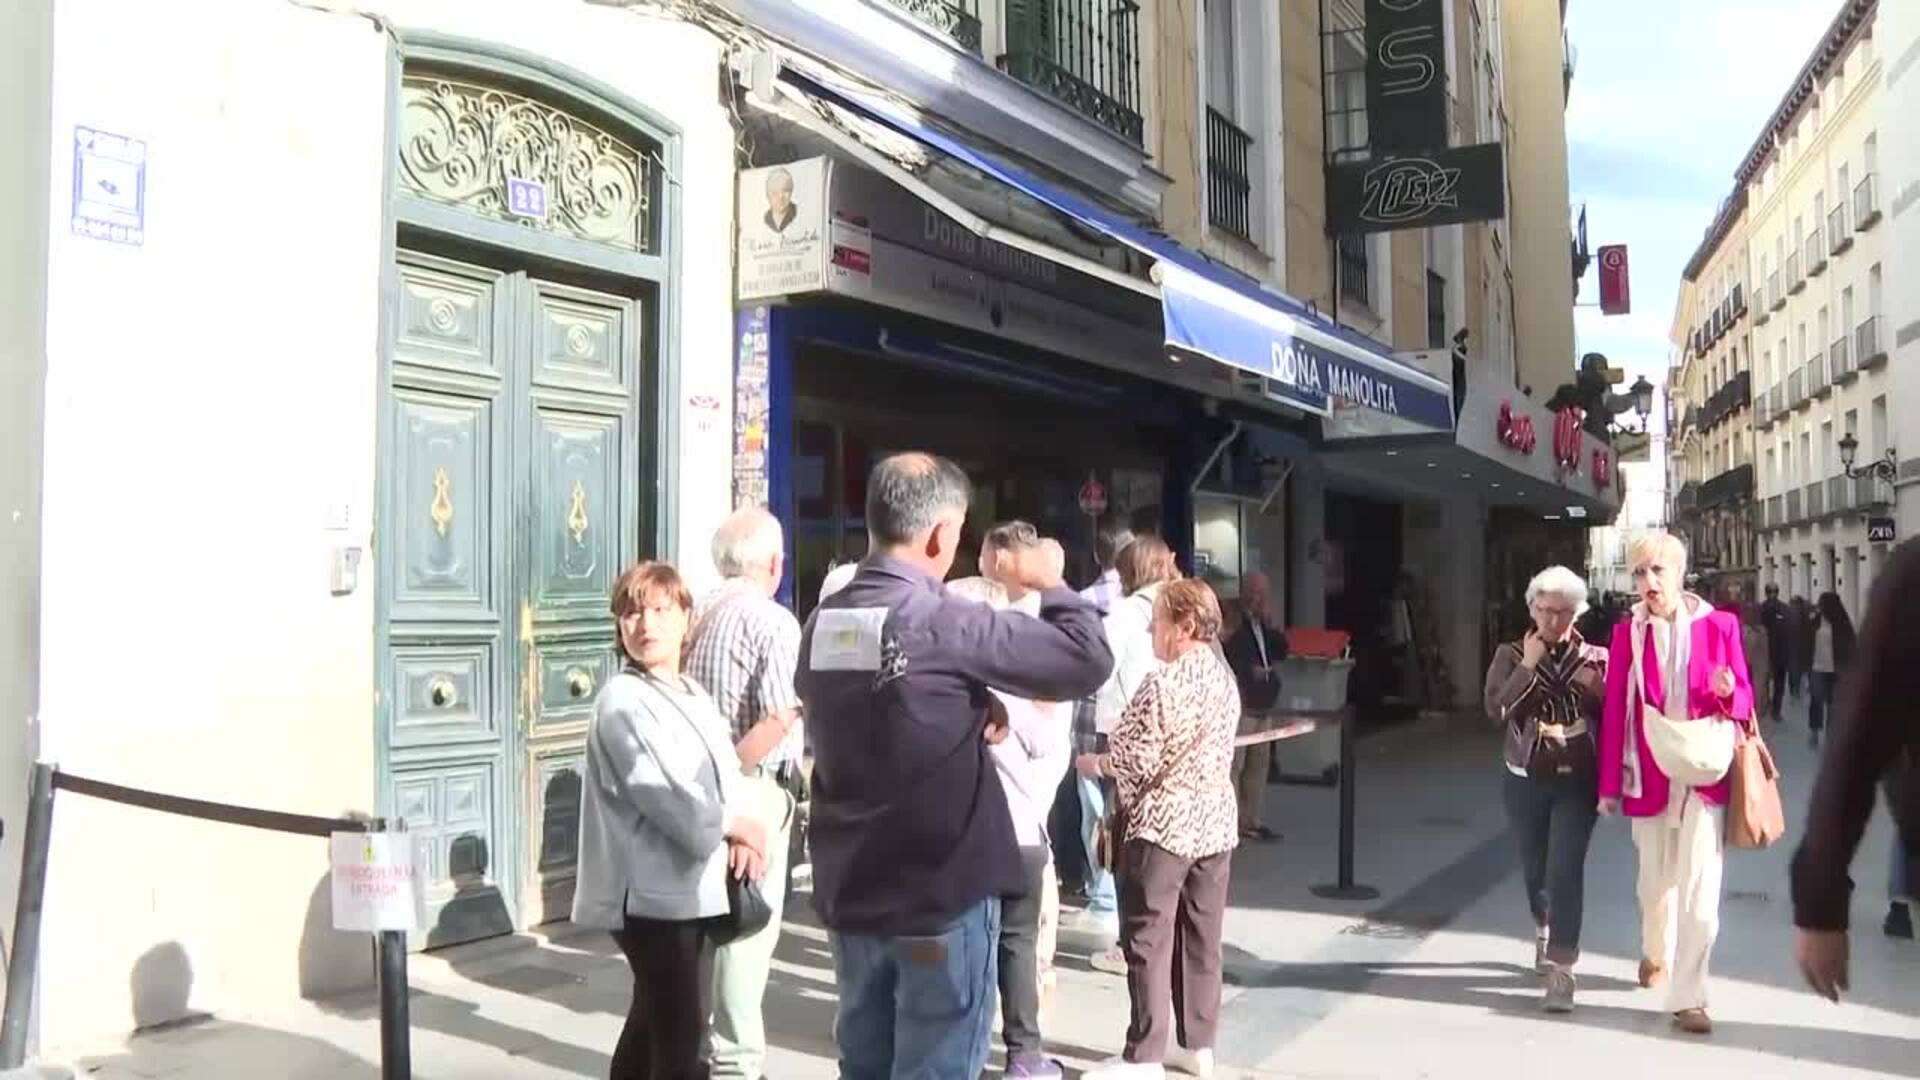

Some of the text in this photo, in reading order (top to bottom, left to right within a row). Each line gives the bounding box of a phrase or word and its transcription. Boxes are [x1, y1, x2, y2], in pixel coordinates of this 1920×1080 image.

[515, 185, 541, 212] 22
[1271, 342, 1398, 414] DOÑA MANOLITA
